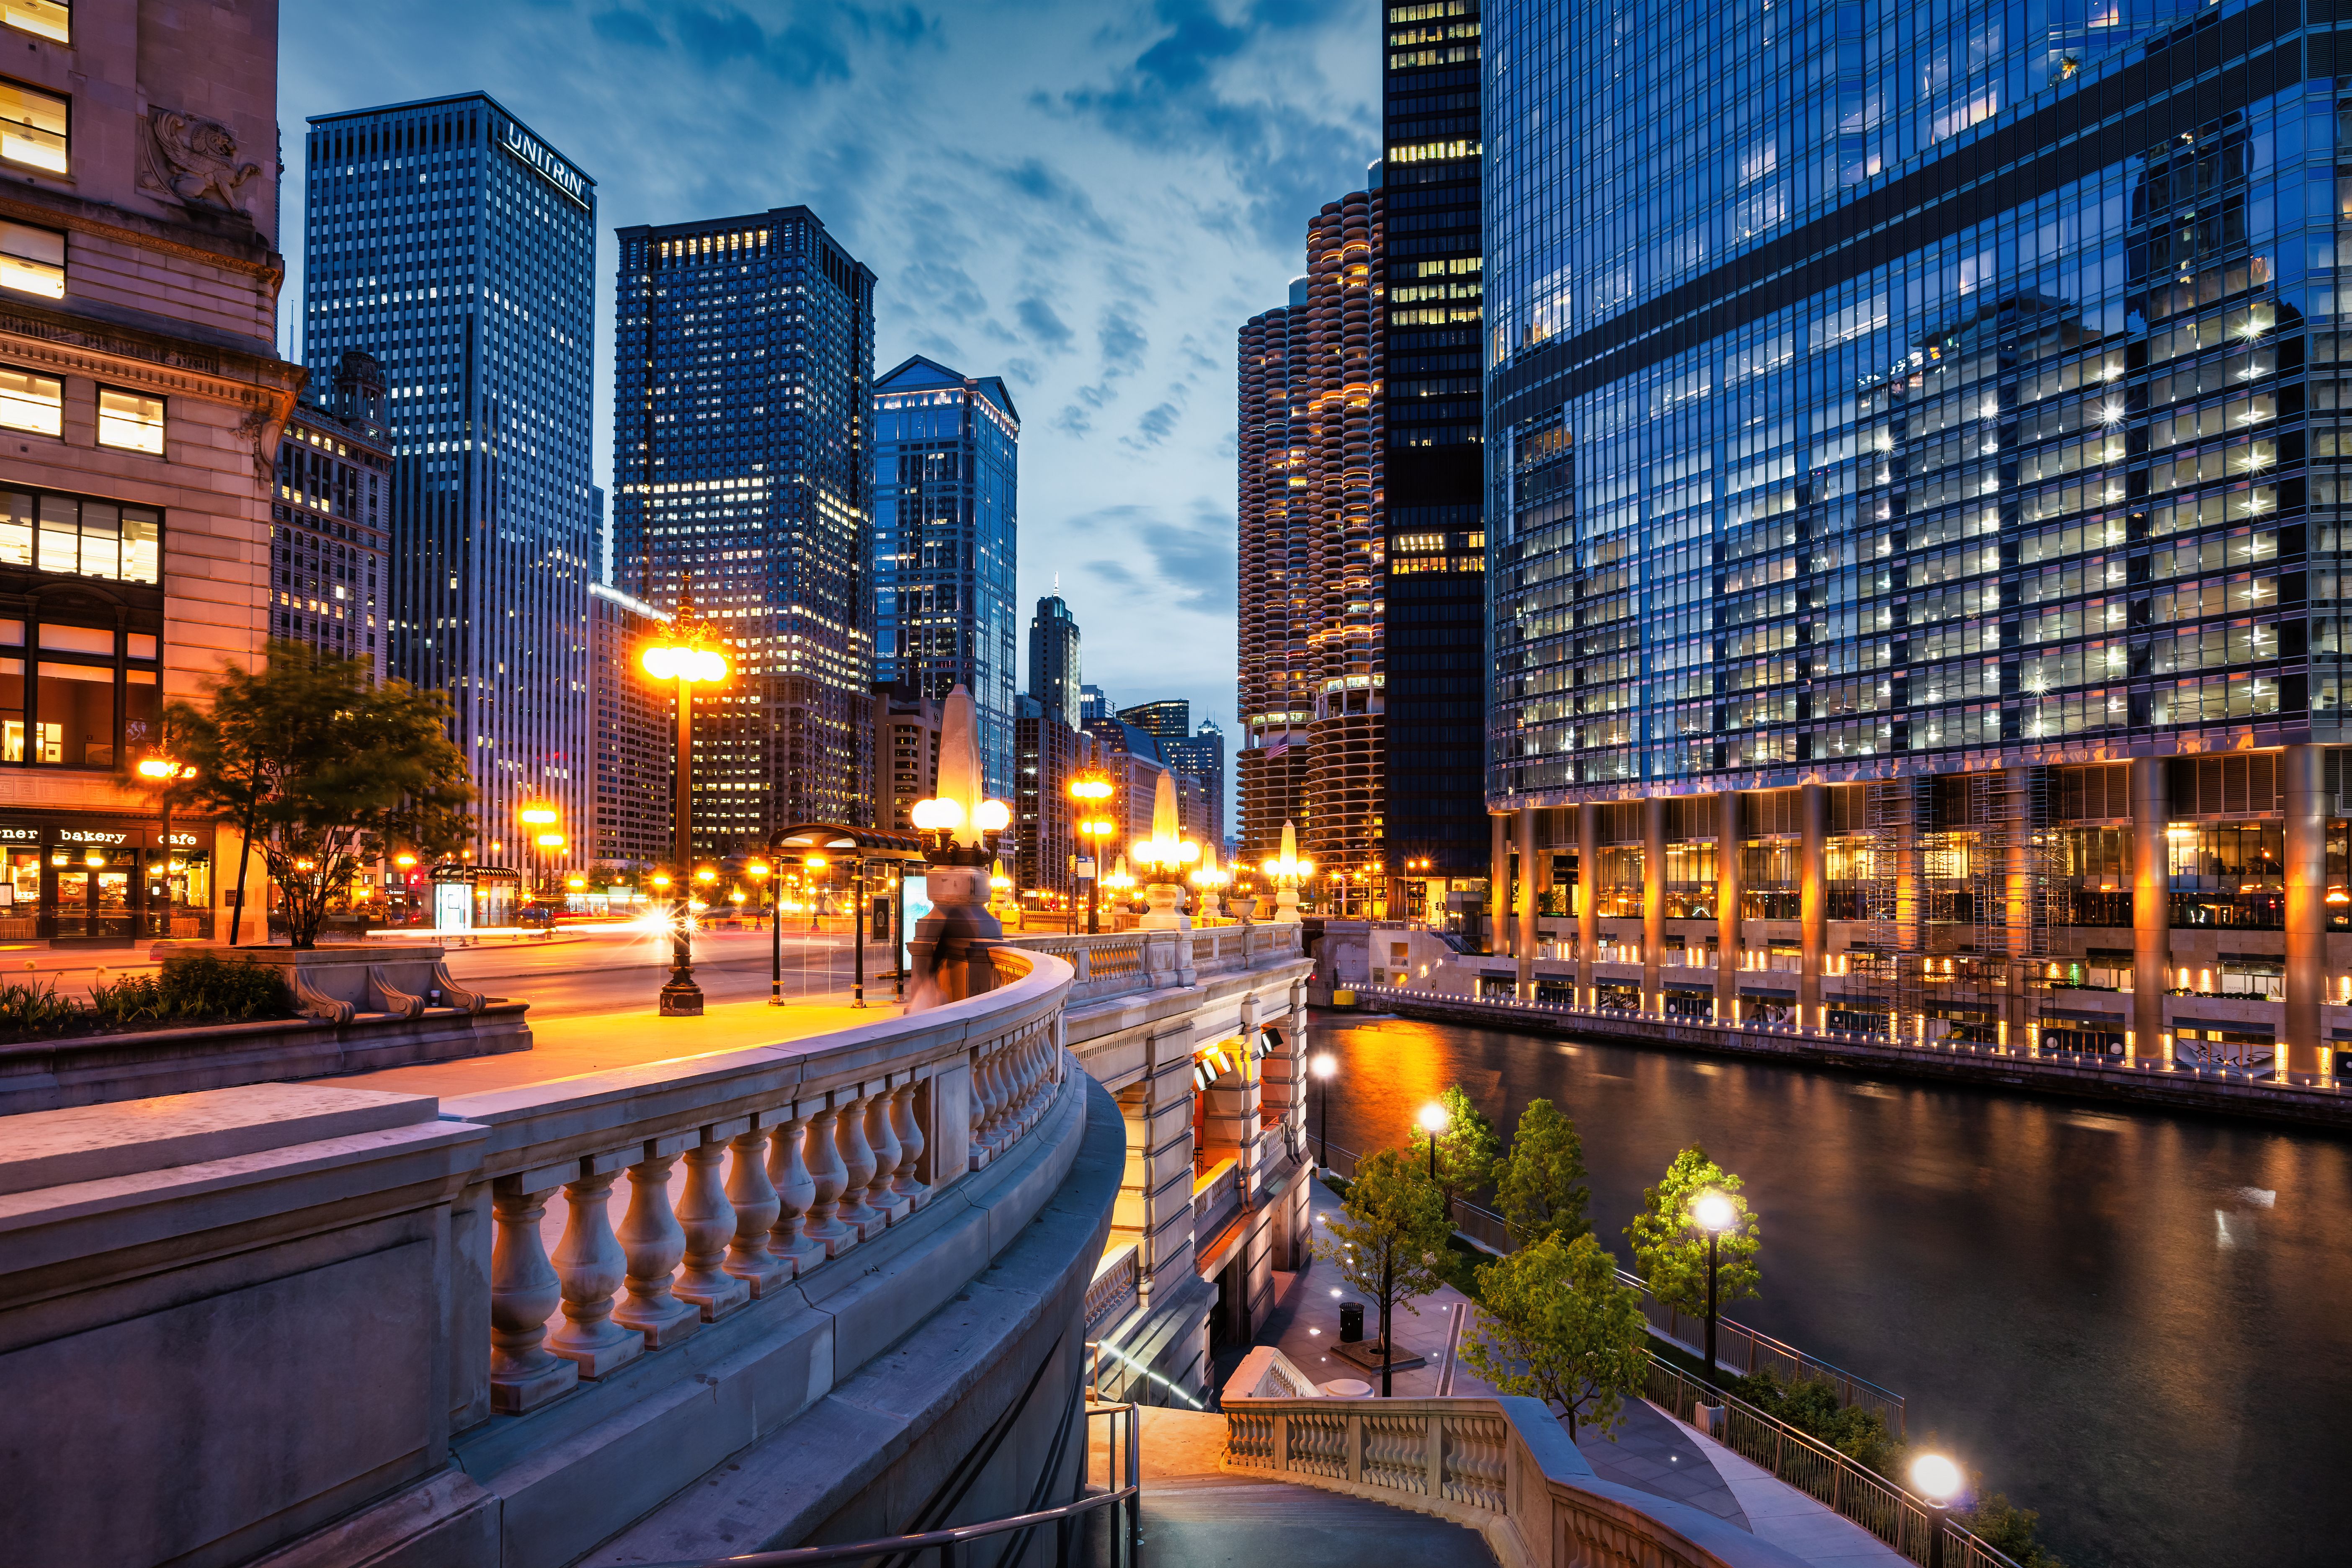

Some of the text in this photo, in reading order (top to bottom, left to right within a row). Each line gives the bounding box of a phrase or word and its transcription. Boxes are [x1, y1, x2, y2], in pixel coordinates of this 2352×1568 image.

[509, 122, 583, 197] UNITRIN
[0, 829, 38, 839] ner
[60, 830, 127, 844] bakery
